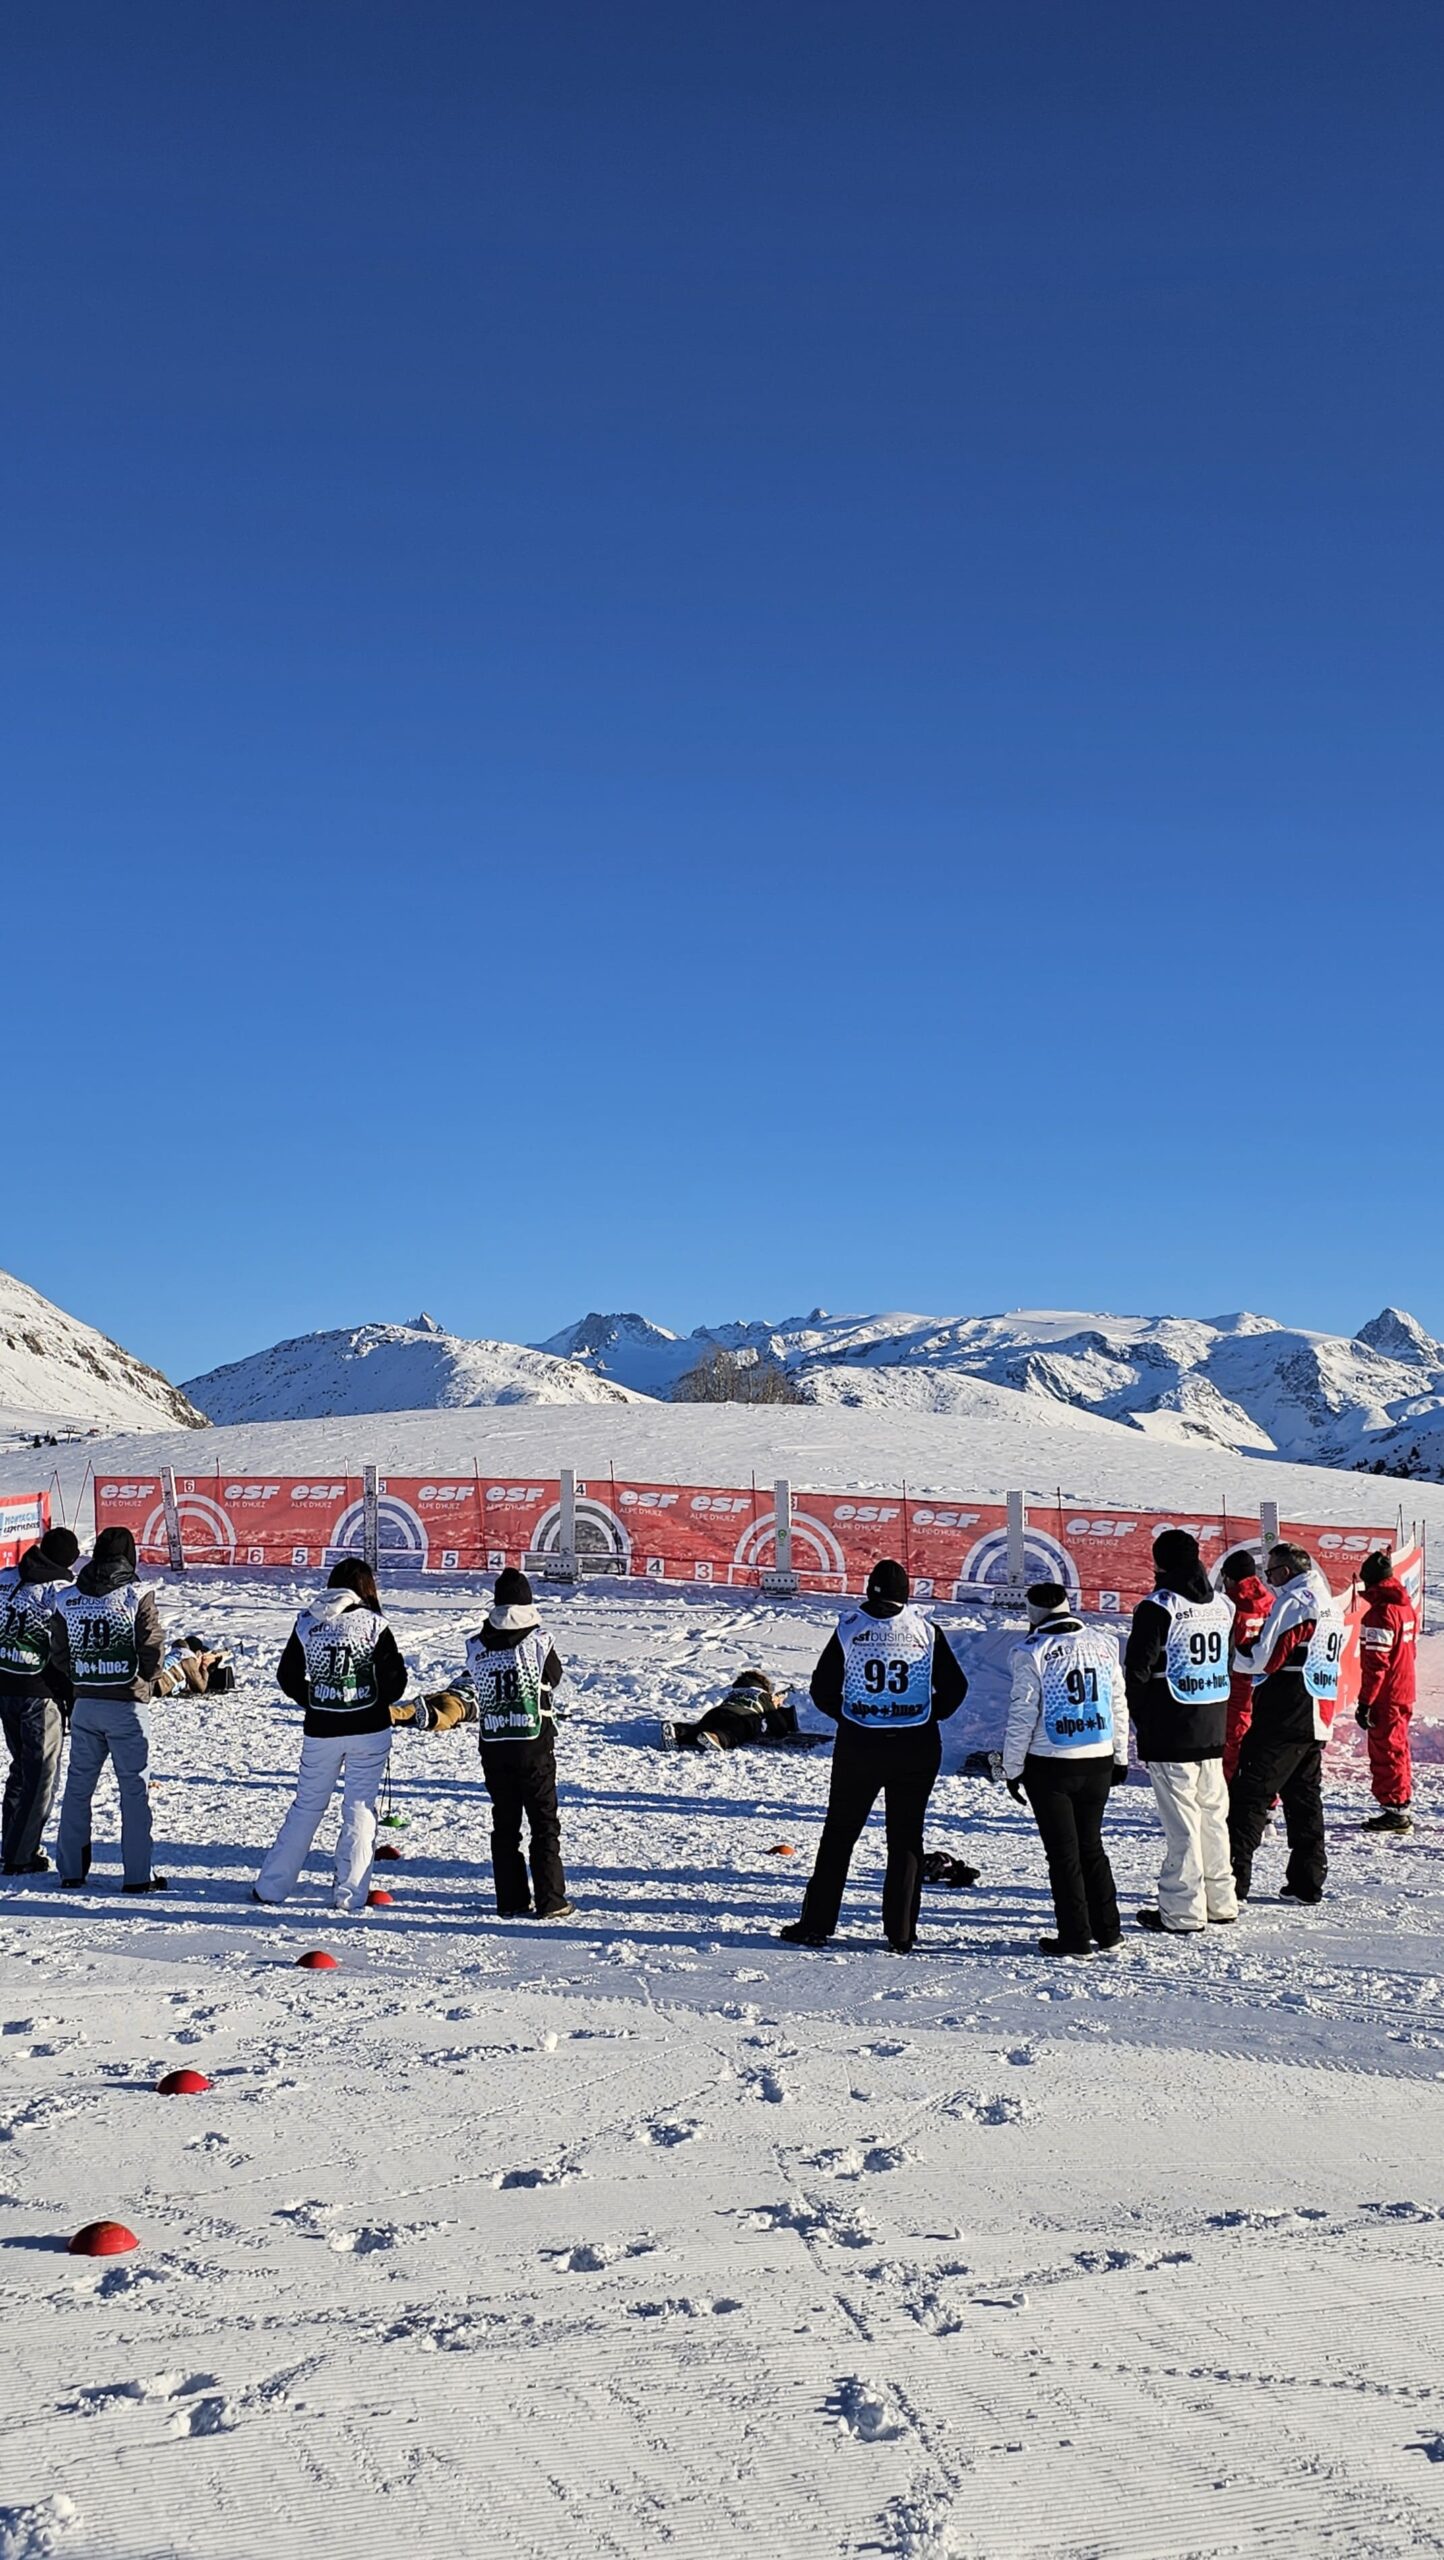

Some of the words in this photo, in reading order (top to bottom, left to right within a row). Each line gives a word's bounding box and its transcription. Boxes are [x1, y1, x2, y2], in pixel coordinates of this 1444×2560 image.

[185, 1480, 194, 1491] 6
[575, 1484, 585, 1495] 4
[250, 1549, 262, 1563] 6
[295, 1549, 306, 1564] 5
[444, 1553, 456, 1567] 5
[489, 1553, 503, 1566] 4
[648, 1559, 662, 1574] 4
[697, 1564, 710, 1579] 3
[916, 1580, 930, 1596] 2
[1102, 1594, 1117, 1610] 2
[1189, 1631, 1221, 1666] 99
[322, 1646, 352, 1676] 77
[864, 1658, 909, 1694] 93
[488, 1669, 518, 1702] 78
[1067, 1667, 1099, 1706] 97
